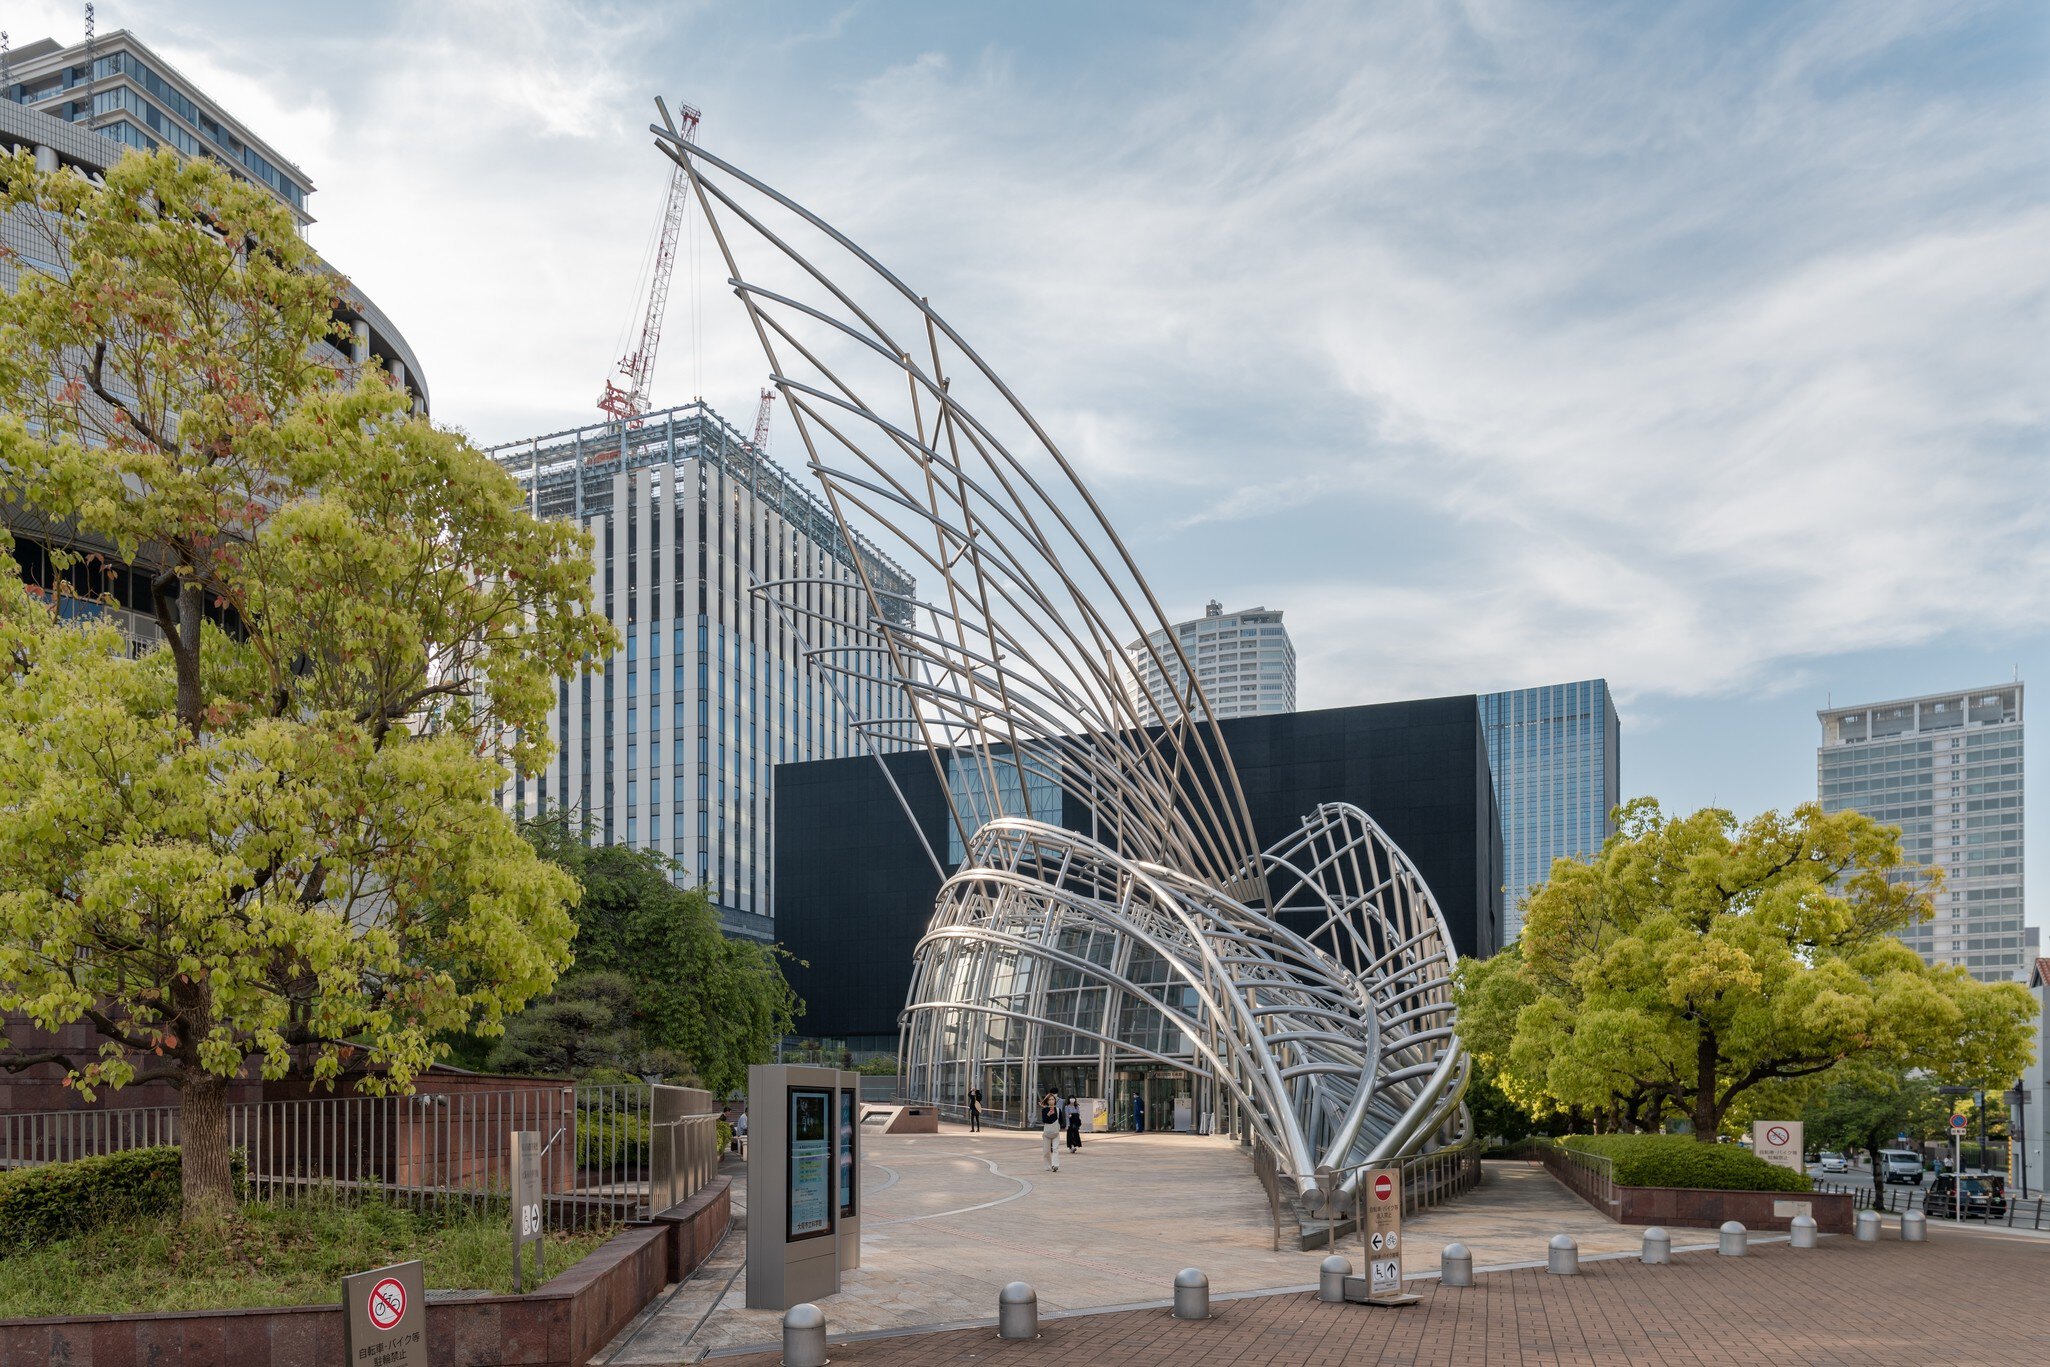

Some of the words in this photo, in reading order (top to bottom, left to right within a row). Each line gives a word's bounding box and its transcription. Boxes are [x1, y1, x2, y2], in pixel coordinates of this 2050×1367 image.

[359, 1332, 420, 1359] 自転車・バイク等
[374, 1349, 407, 1367] 駐輪禁止
